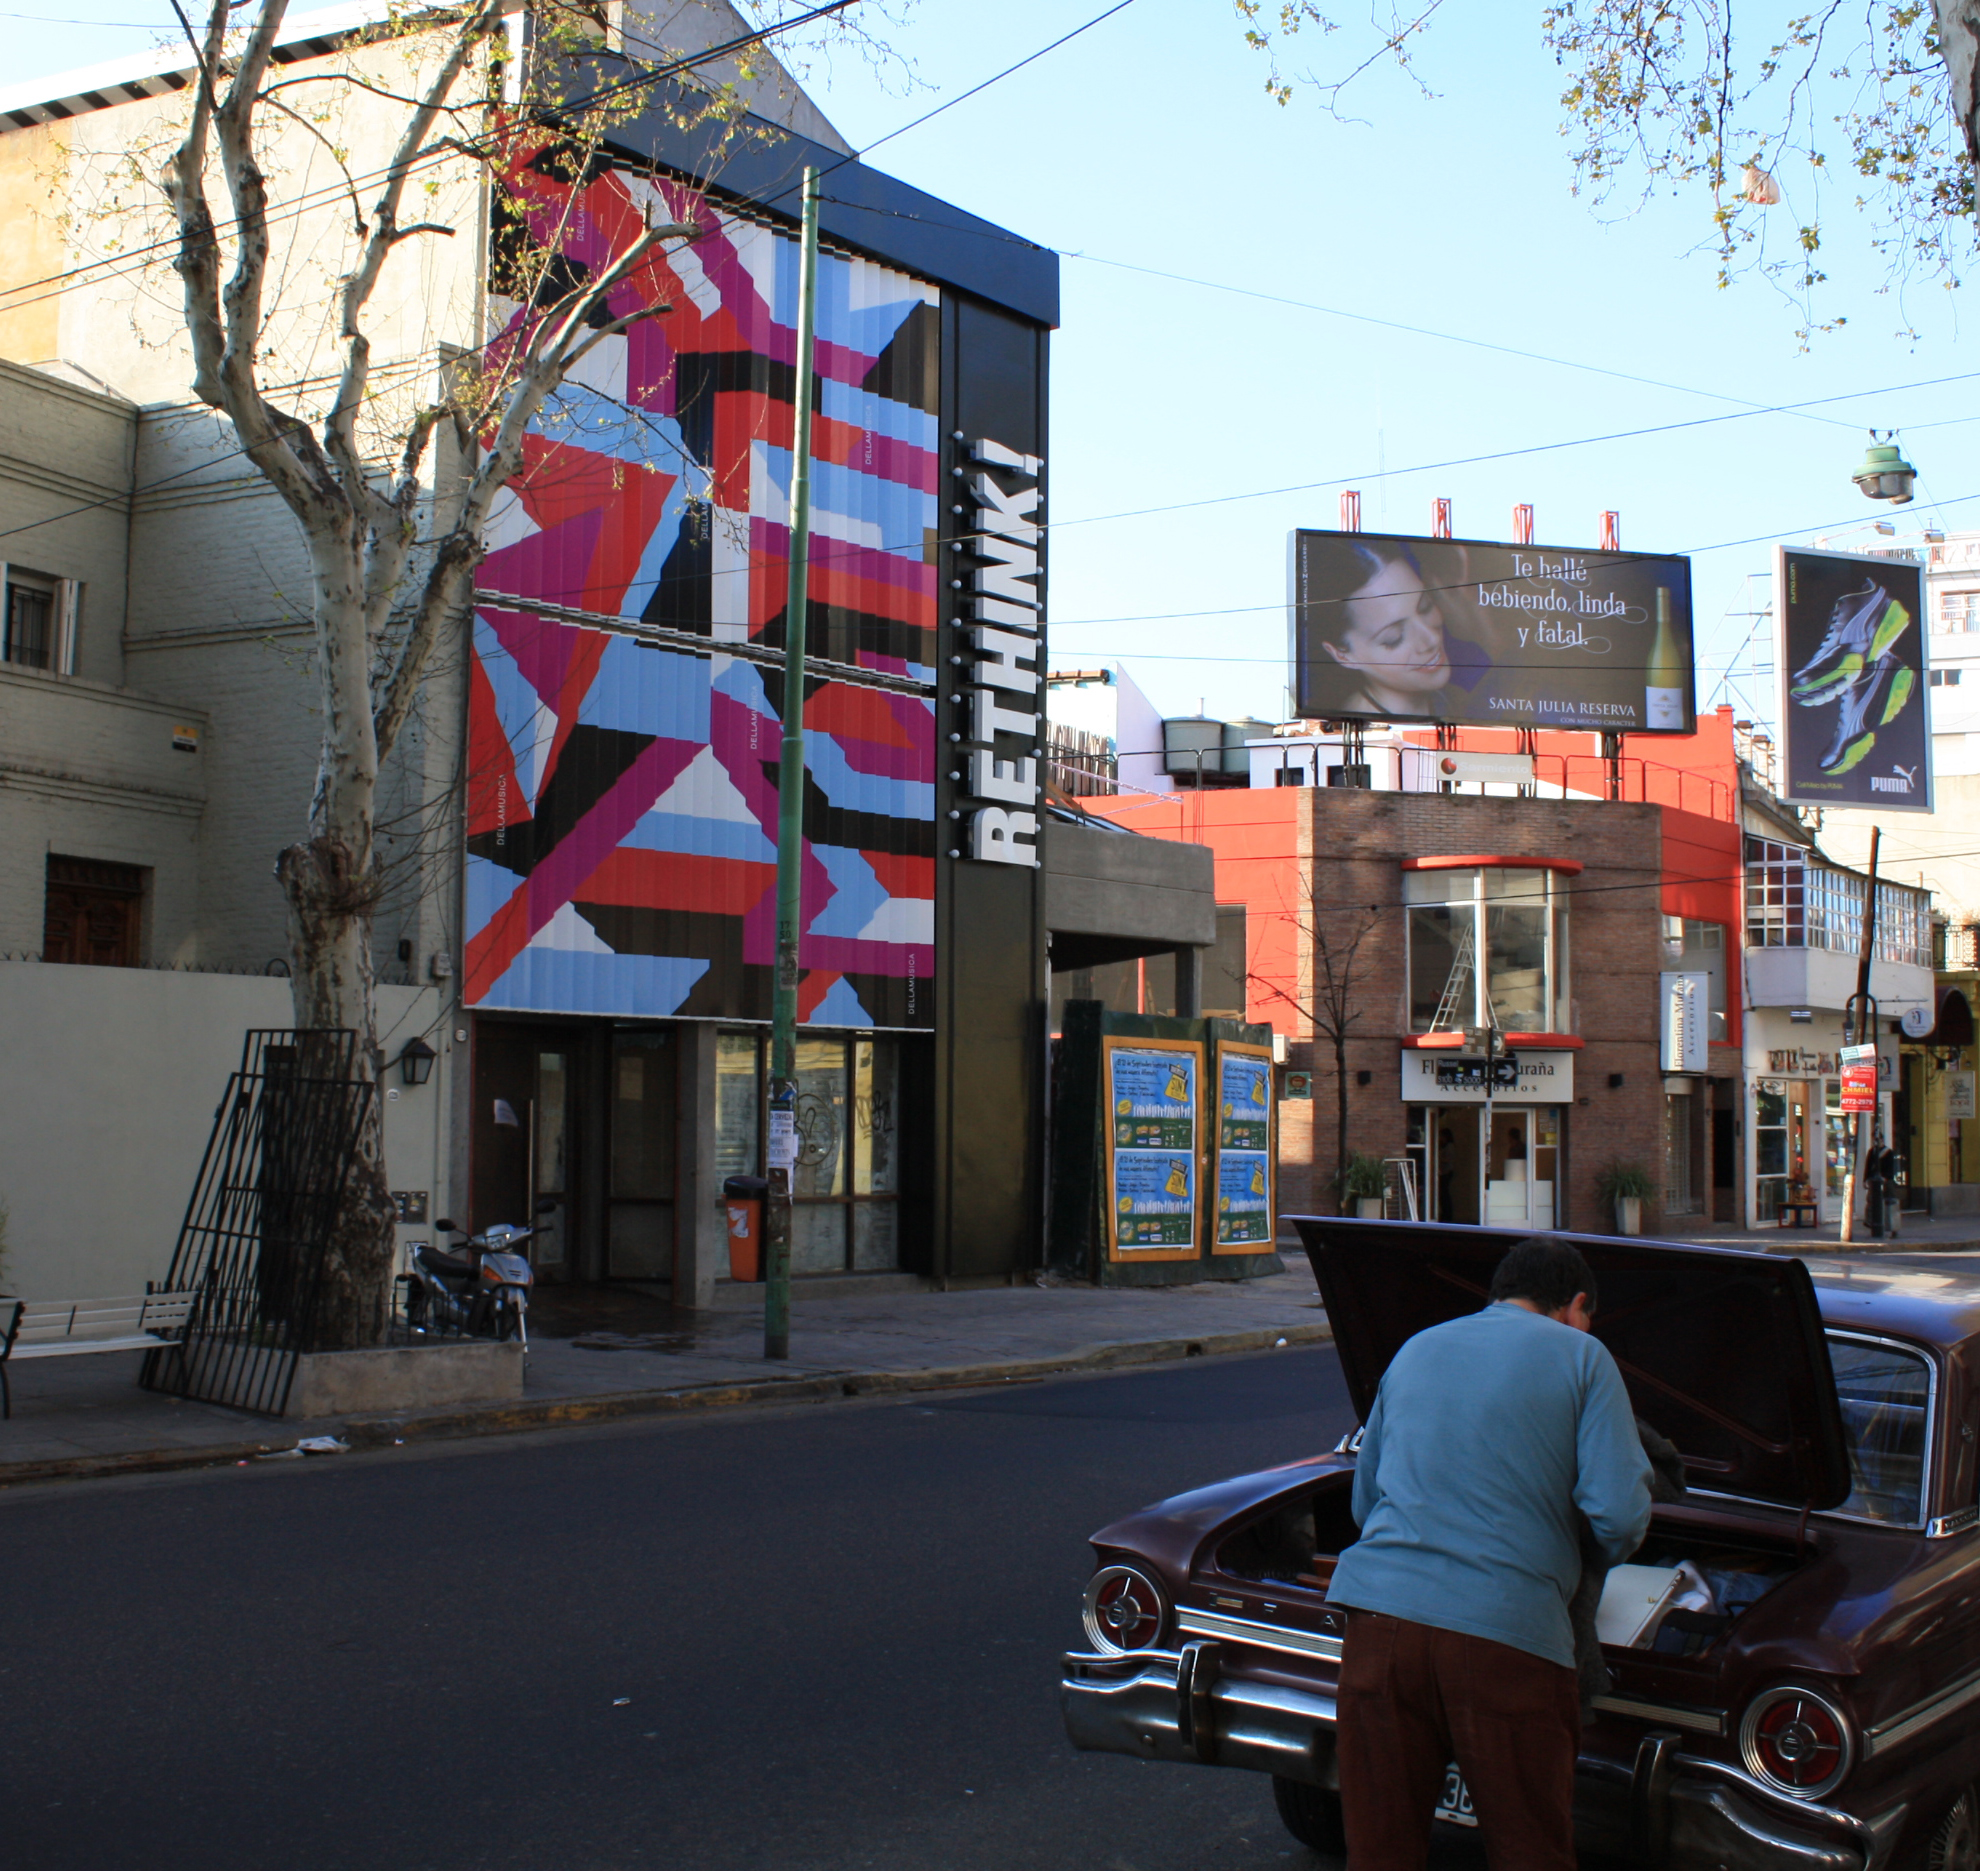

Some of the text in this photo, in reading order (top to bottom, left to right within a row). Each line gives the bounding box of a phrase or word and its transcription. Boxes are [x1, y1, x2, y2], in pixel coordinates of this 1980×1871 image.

[1511, 554, 1588, 581] Te hallé
[1789, 563, 1797, 604] puma.com
[1478, 583, 1626, 615] bebiendo, linda
[1517, 620, 1589, 648] y fatal.
[972, 438, 1038, 867] RETHINK!
[750, 685, 758, 750] DELLAMUSICA
[1489, 697, 1636, 717] SANTA JULIA RESERVA
[1460, 761, 1530, 774] Sarmiento
[1871, 776, 1909, 793] PUMA
[496, 774, 506, 846] DELLAMUSICA
[1674, 1018, 1684, 1067] Florentina
